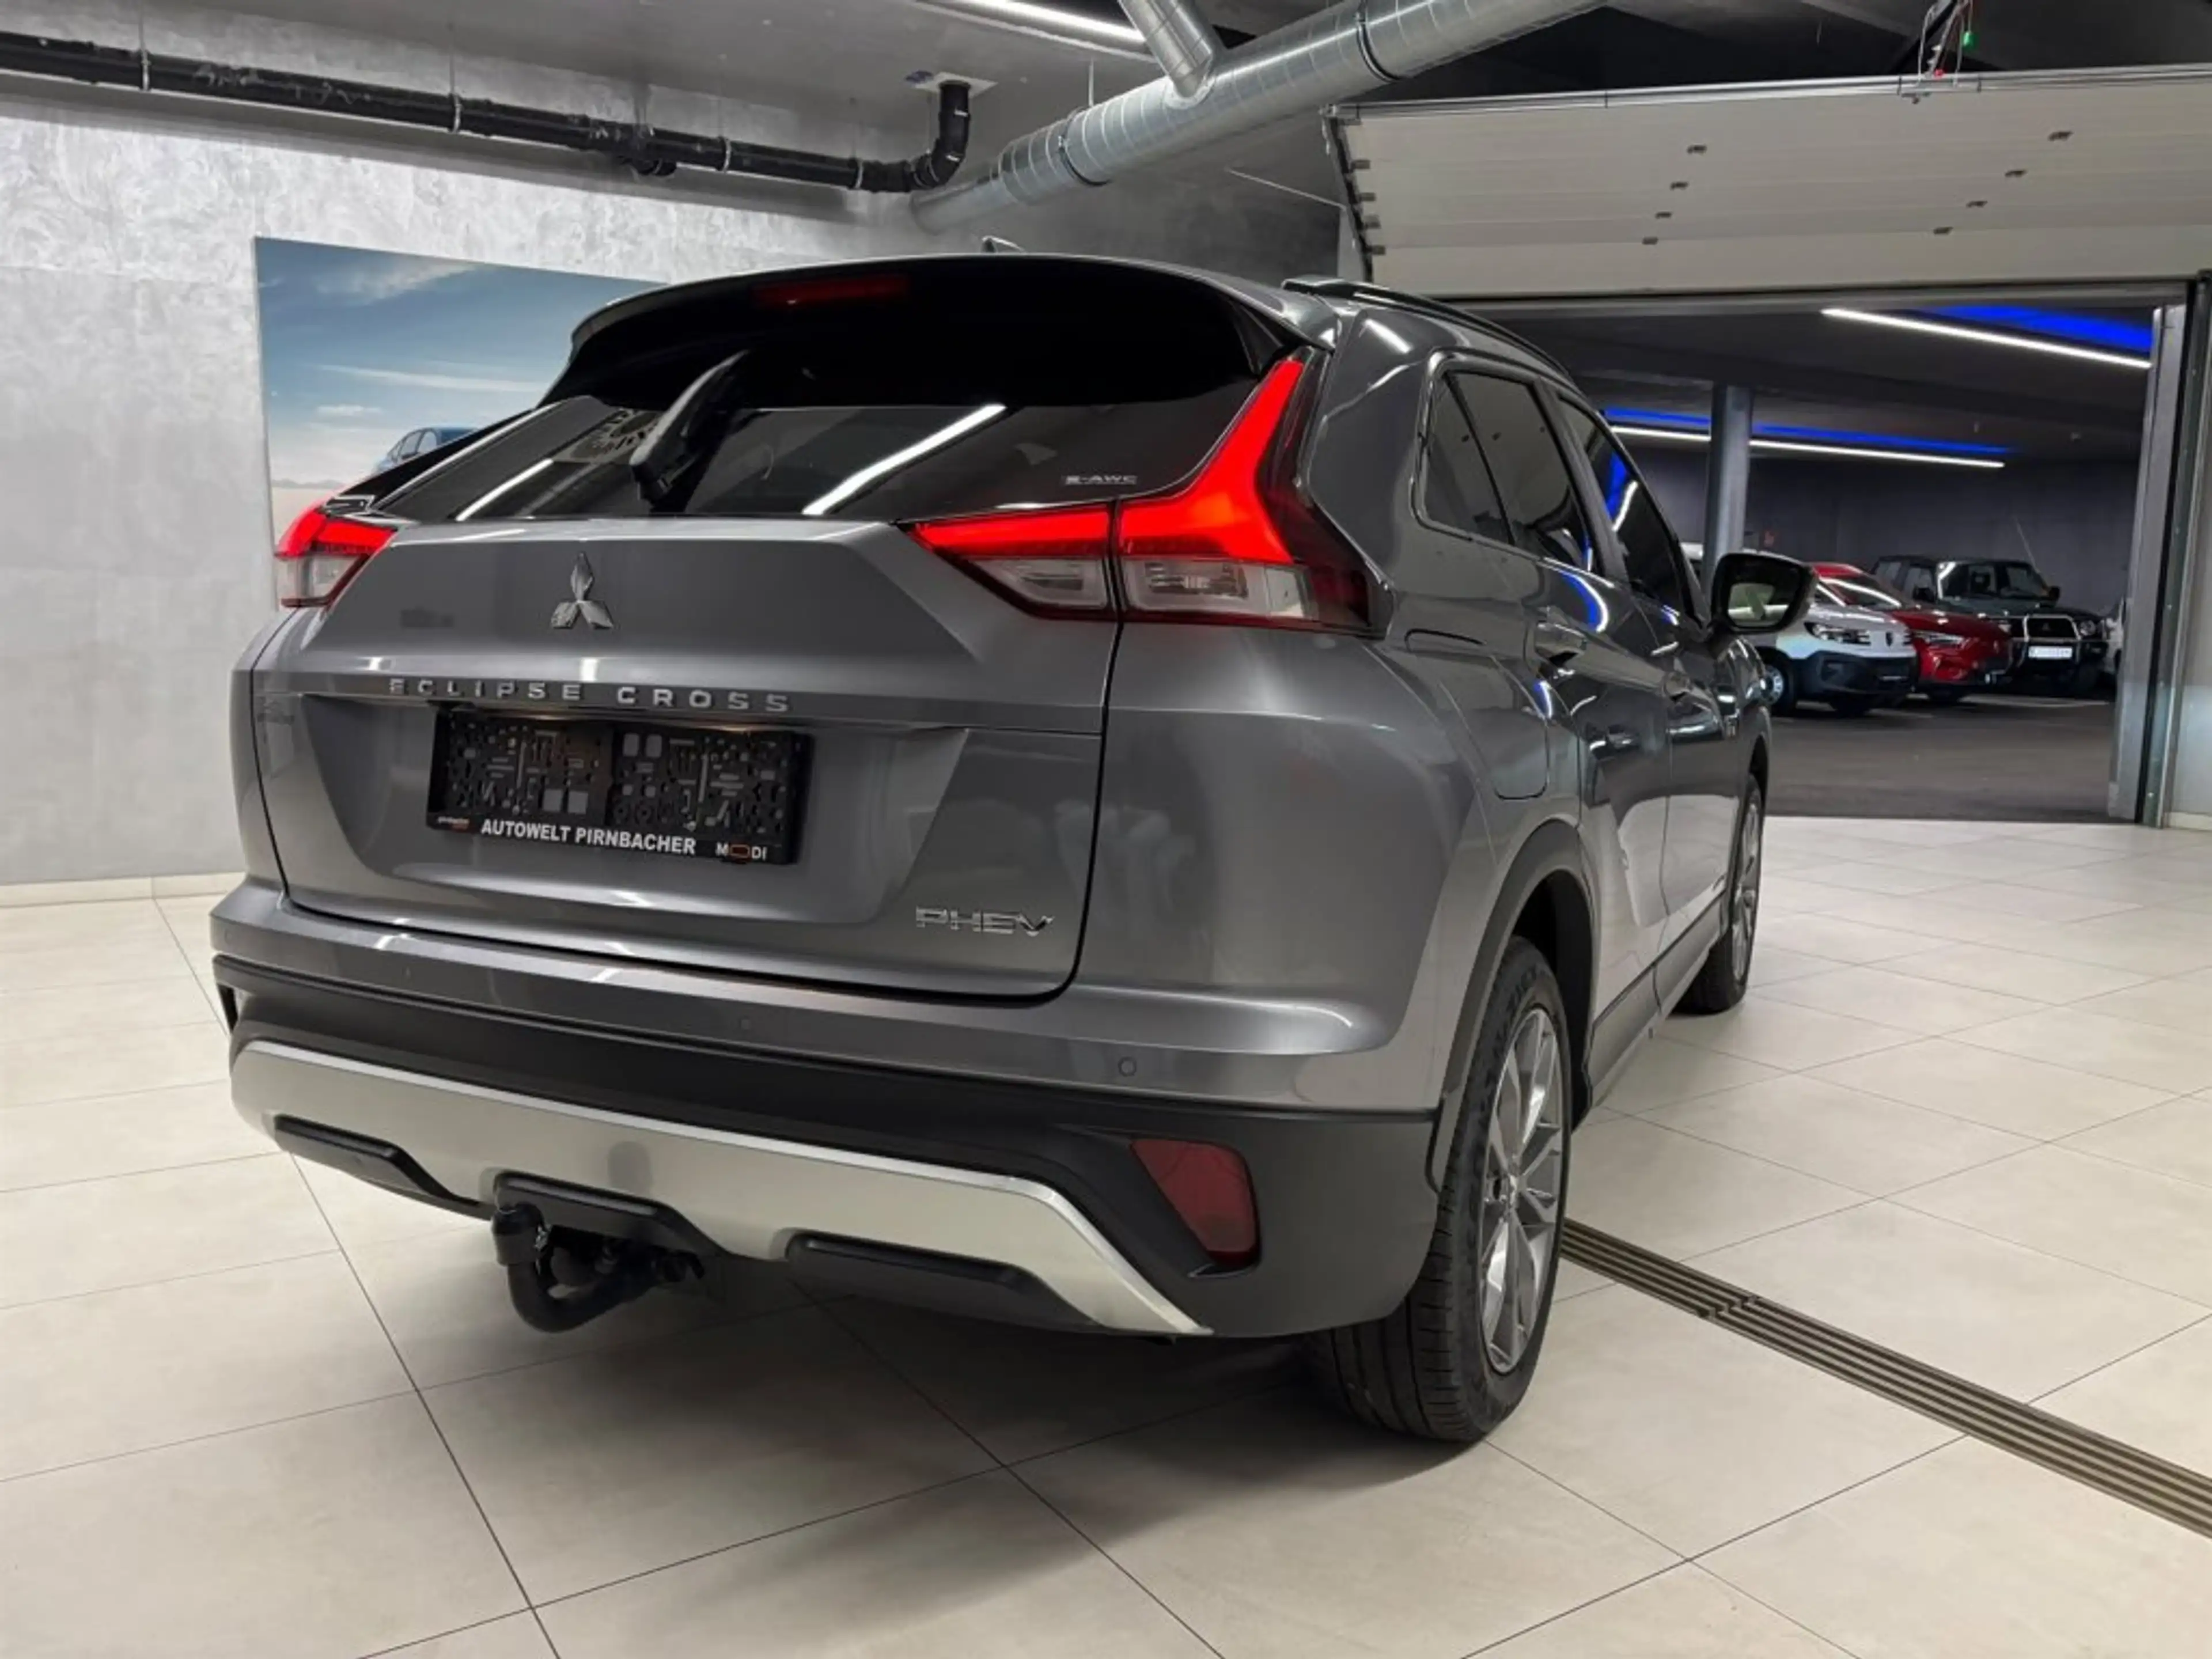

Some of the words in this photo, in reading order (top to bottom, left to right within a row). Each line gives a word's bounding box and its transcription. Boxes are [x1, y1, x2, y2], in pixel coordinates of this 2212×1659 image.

[389, 678, 581, 700] ECLIPSE
[617, 686, 788, 712] CROSS
[480, 819, 571, 842] AUTOWELT
[575, 827, 696, 855] PIRNBACHER
[916, 906, 1055, 937] PHEV
